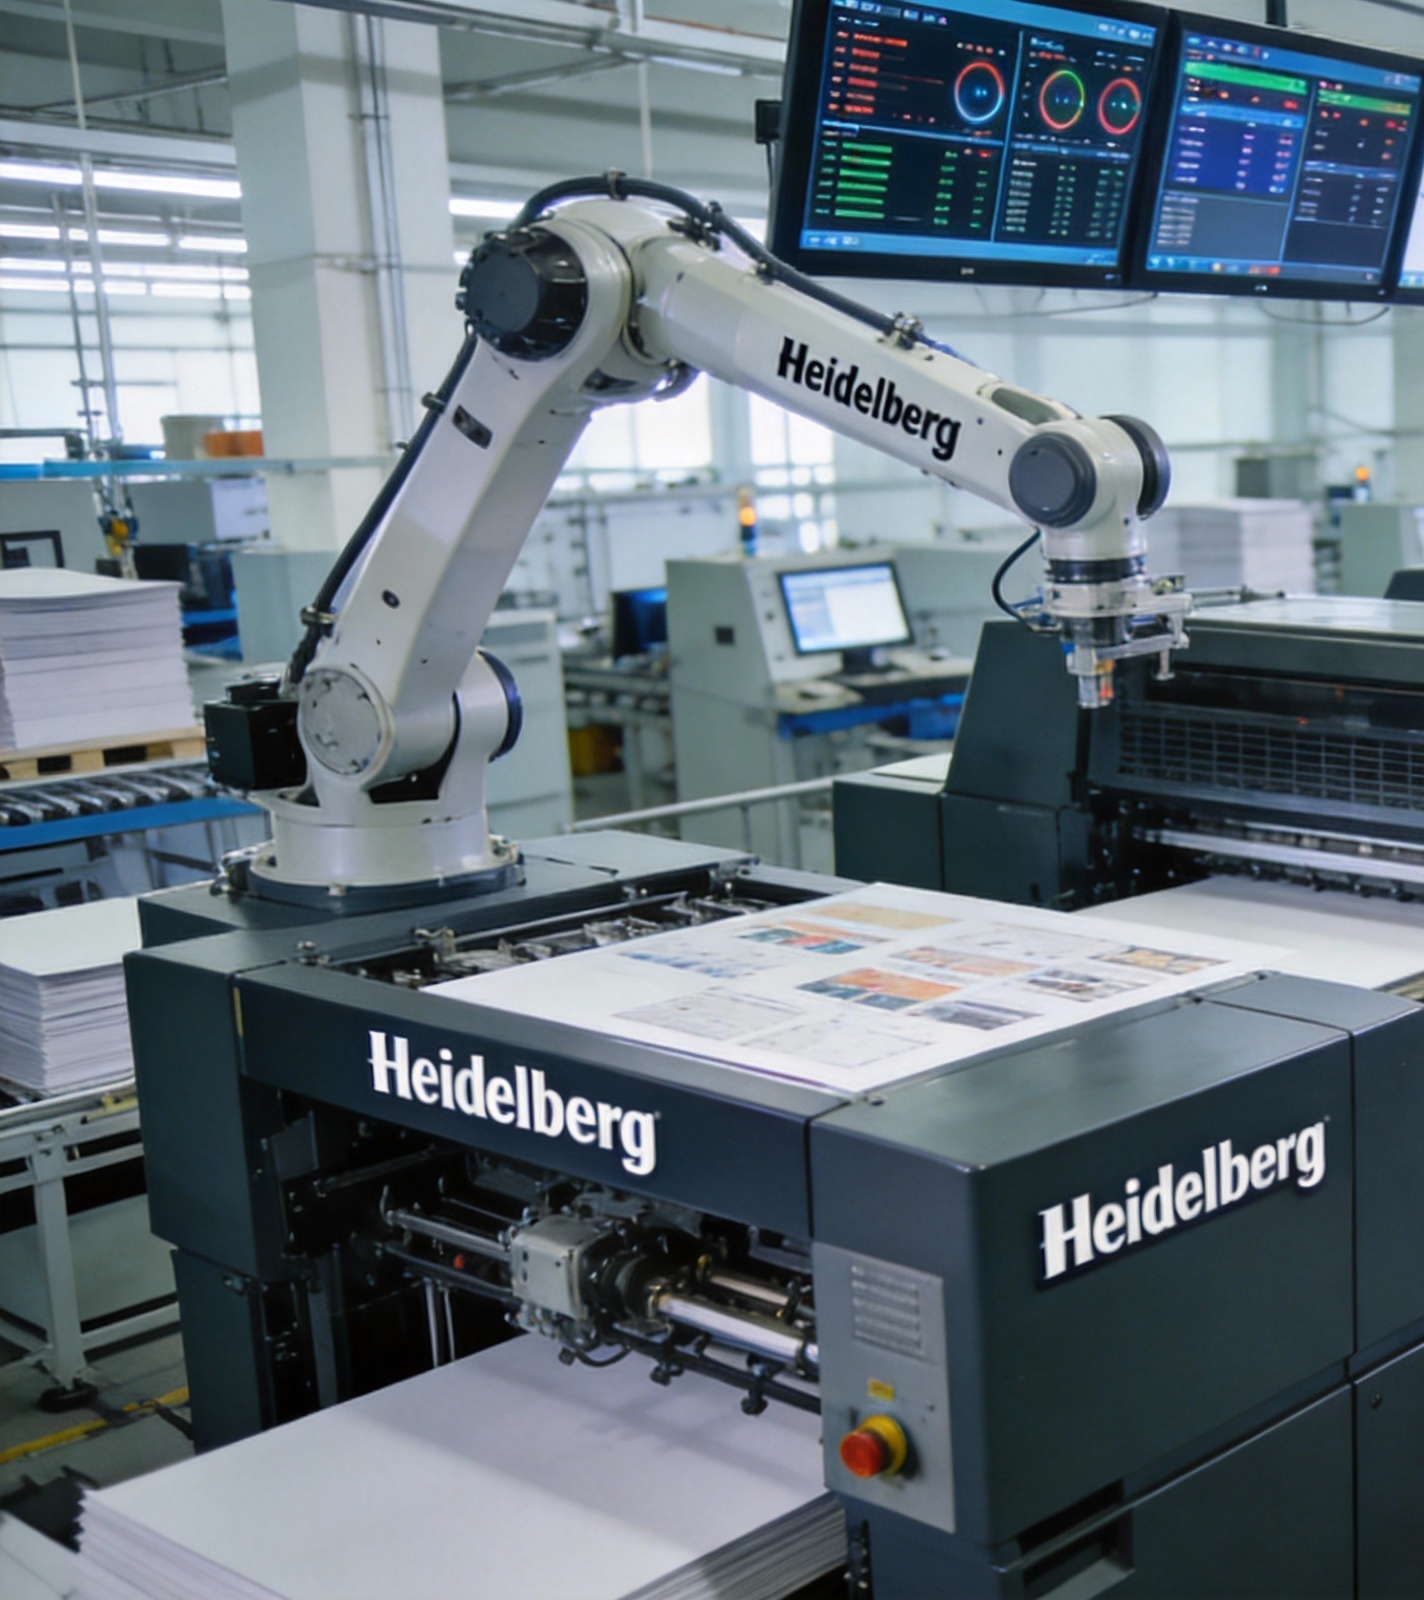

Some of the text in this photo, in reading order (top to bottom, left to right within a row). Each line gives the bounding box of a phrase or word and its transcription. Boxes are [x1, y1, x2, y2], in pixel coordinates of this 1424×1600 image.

[777, 336, 962, 461] Heidelberg
[367, 1030, 657, 1175] Heidelberg
[1038, 1121, 1326, 1280] Heidelberg
